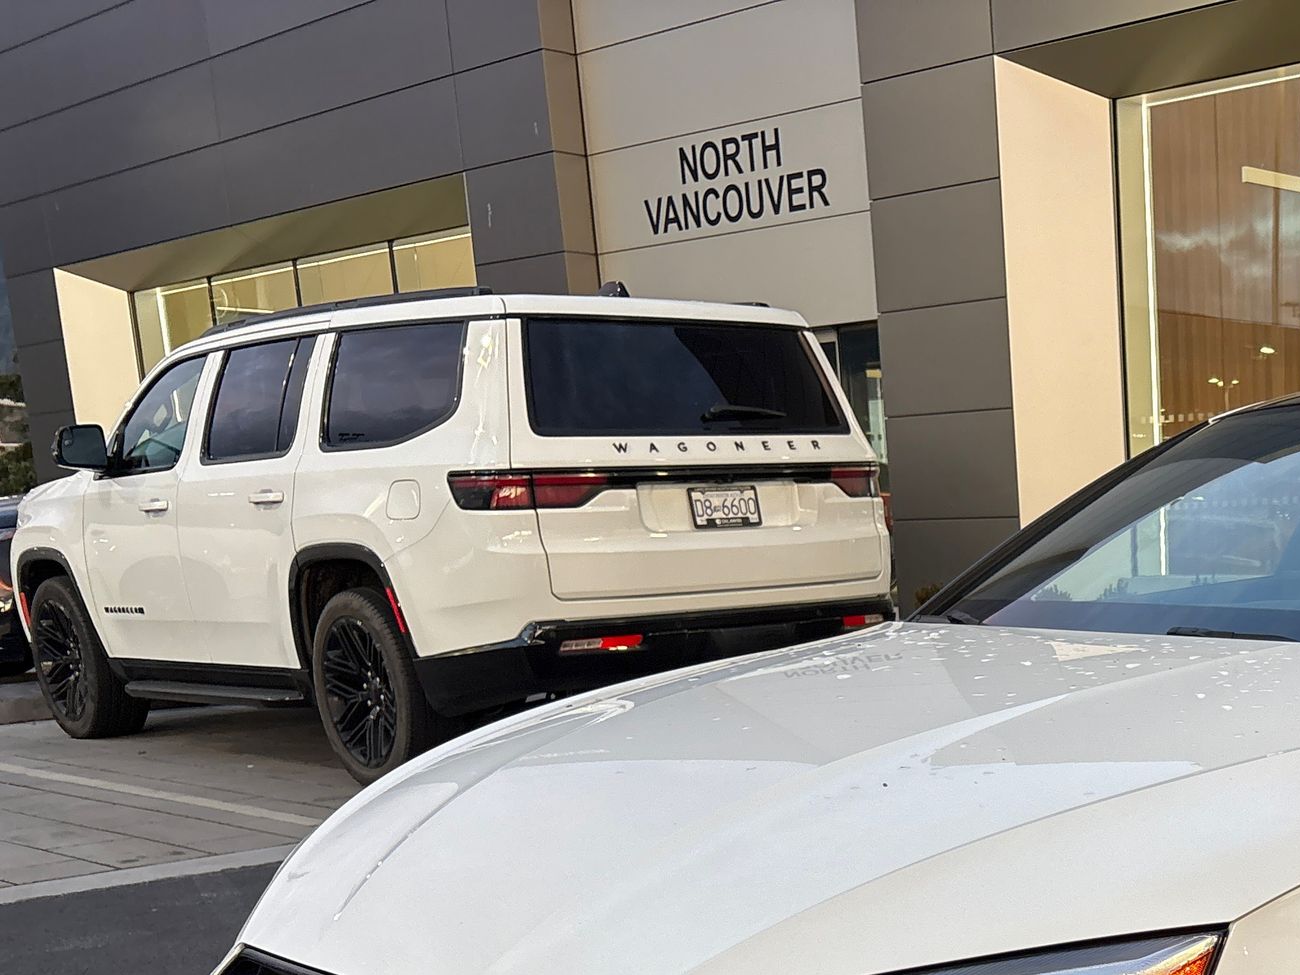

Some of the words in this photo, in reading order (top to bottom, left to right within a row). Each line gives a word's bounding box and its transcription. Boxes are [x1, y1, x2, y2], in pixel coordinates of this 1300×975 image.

[679, 128, 782, 185] NORTH
[644, 168, 830, 235] VANCOUVER
[613, 440, 821, 454] WAGONEER
